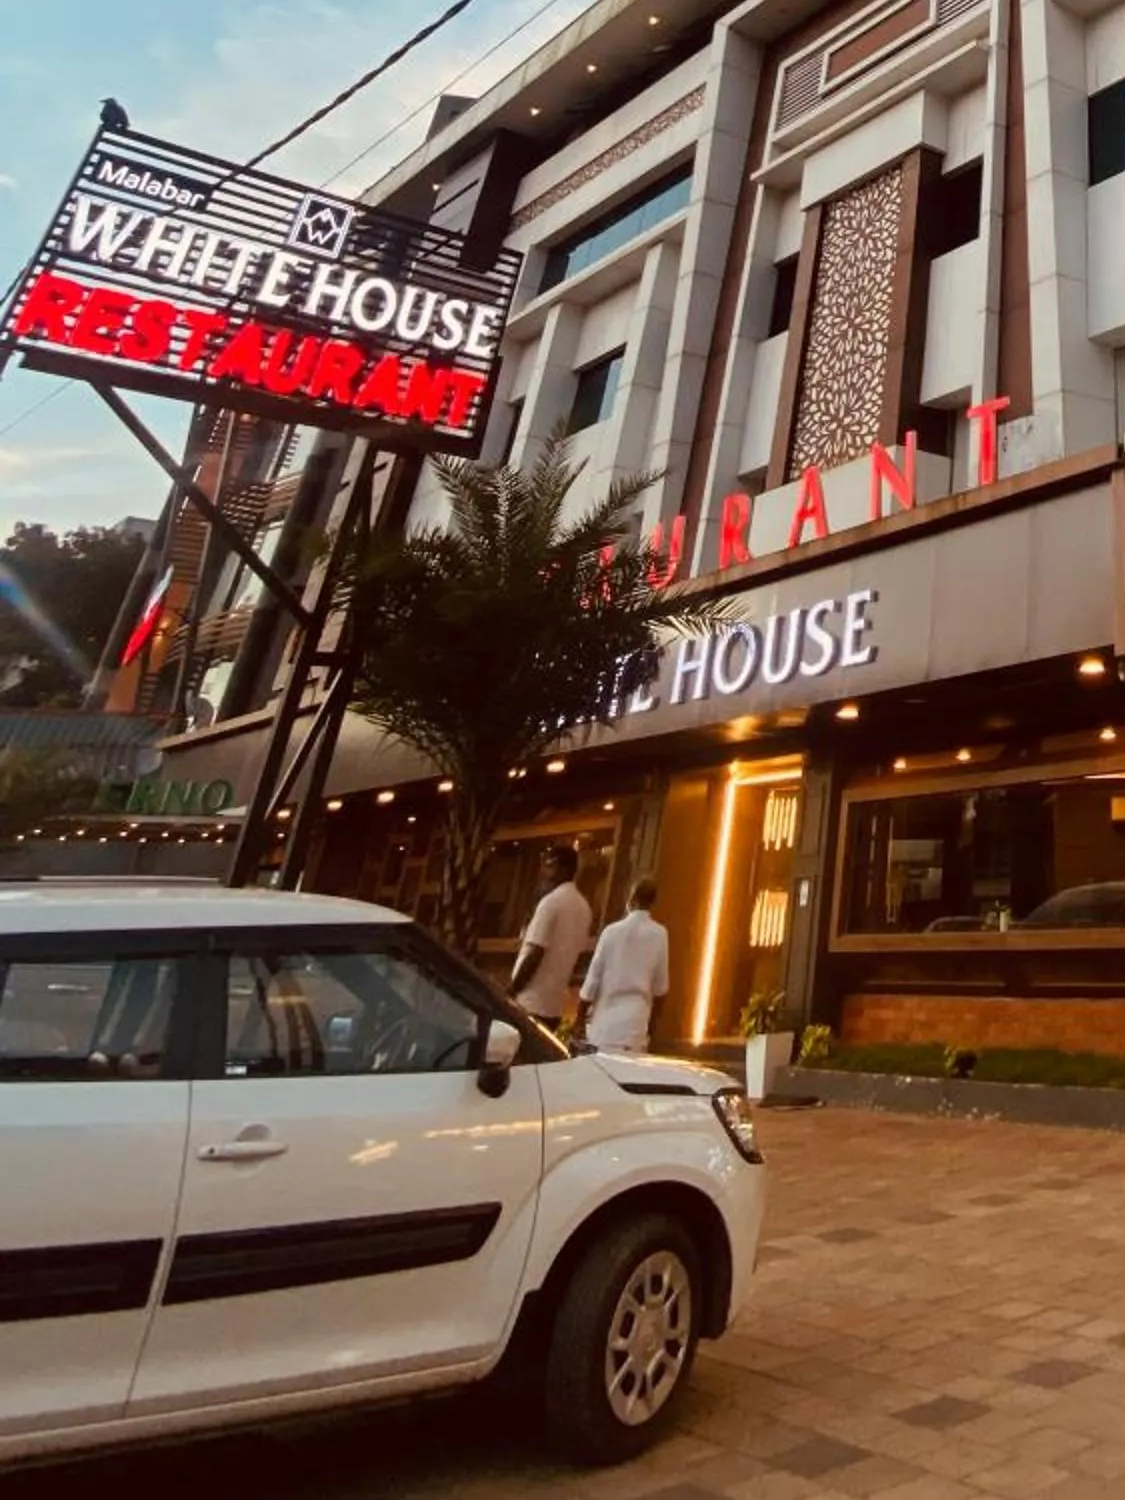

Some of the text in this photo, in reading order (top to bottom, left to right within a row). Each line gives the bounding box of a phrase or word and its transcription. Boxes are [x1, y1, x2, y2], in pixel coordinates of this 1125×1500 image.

[98, 160, 205, 208] Malabar
[66, 194, 504, 357] WHITE HOUSE
[13, 272, 487, 427] RESTAURANT
[669, 588, 878, 706] HOUSE
